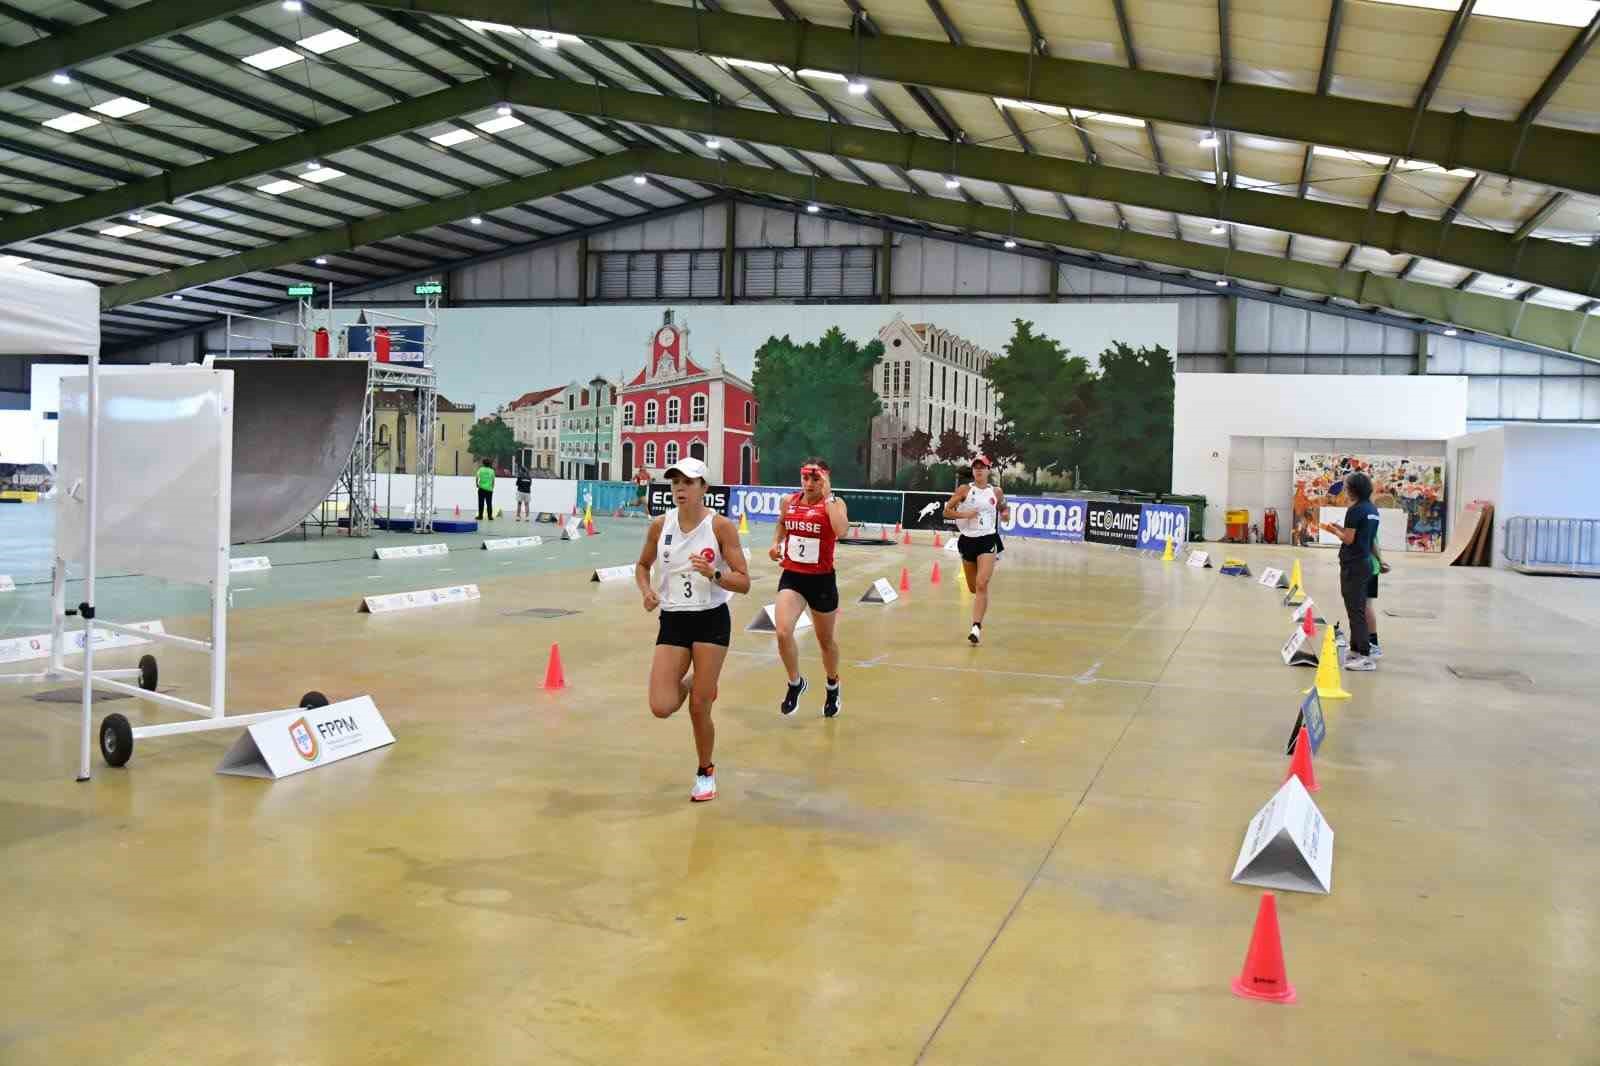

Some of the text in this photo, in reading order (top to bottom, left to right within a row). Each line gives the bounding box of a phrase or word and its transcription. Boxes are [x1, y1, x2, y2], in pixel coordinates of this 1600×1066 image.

[1089, 509, 1140, 531] ECOAIMS
[798, 543, 806, 558] 2
[683, 581, 693, 599] 3
[316, 715, 360, 740] FPPM
